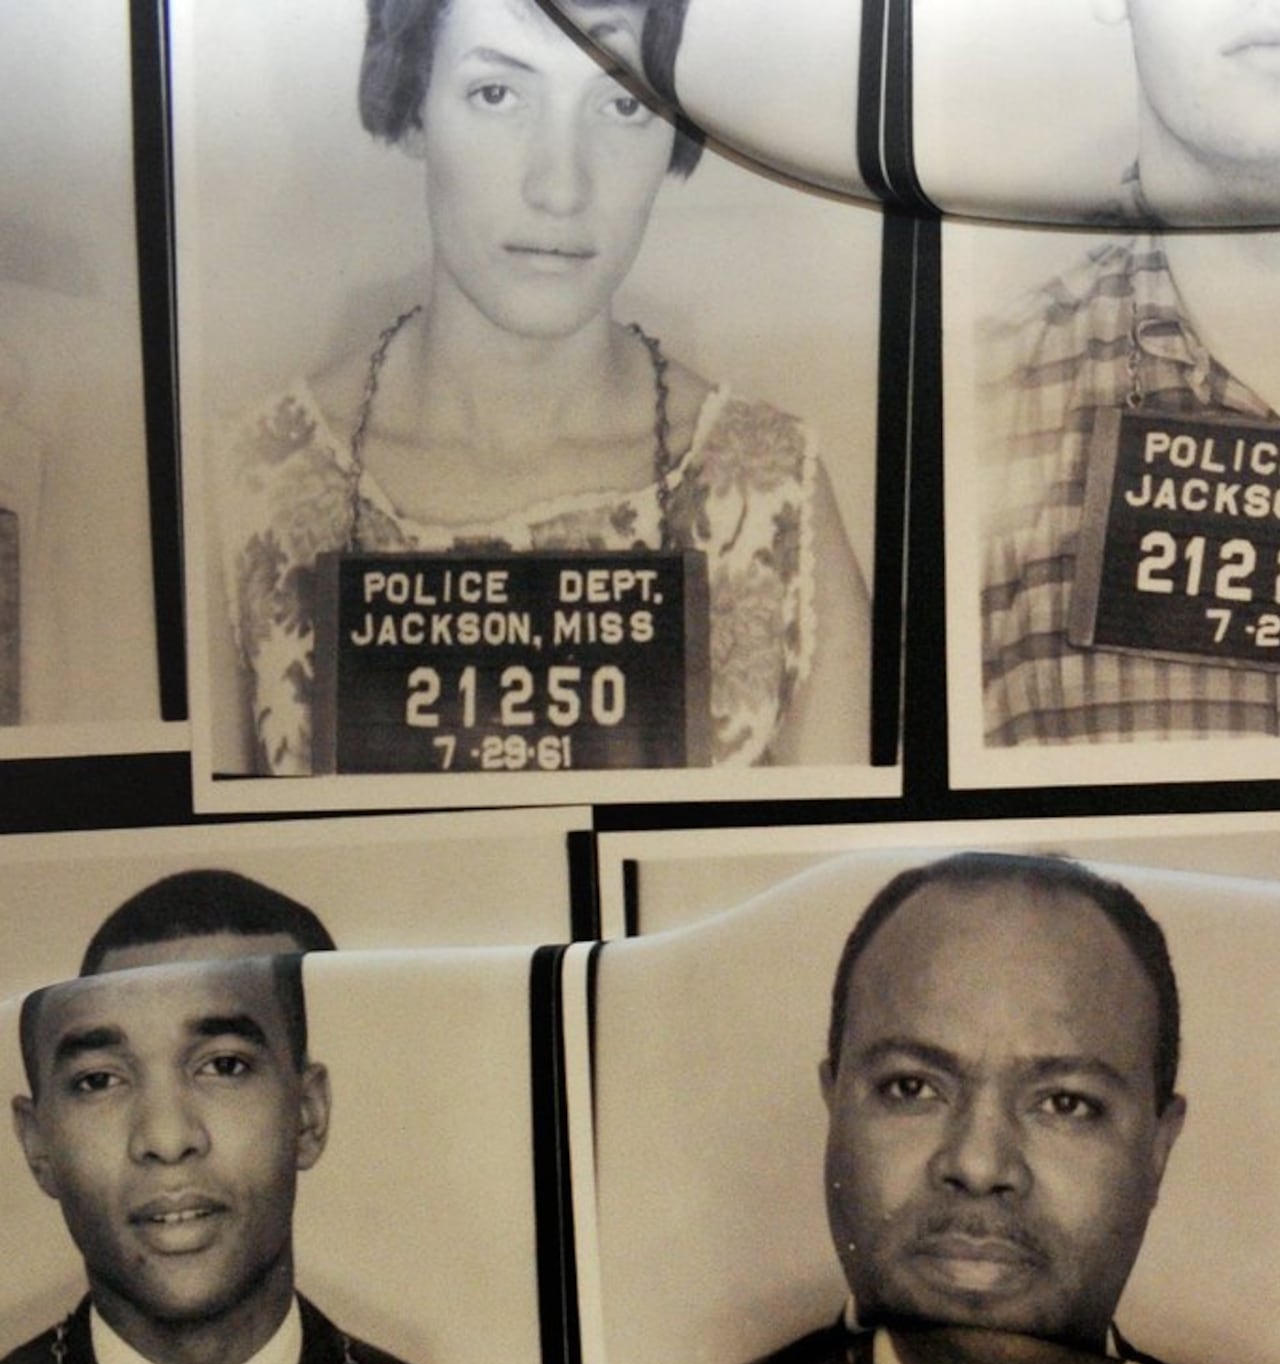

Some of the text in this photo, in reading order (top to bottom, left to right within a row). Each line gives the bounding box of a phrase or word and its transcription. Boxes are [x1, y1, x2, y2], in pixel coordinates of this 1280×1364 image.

[363, 570, 663, 605] POLICE DEPT.
[350, 610, 654, 651] JACKSON, MISS
[405, 665, 626, 727] 21250
